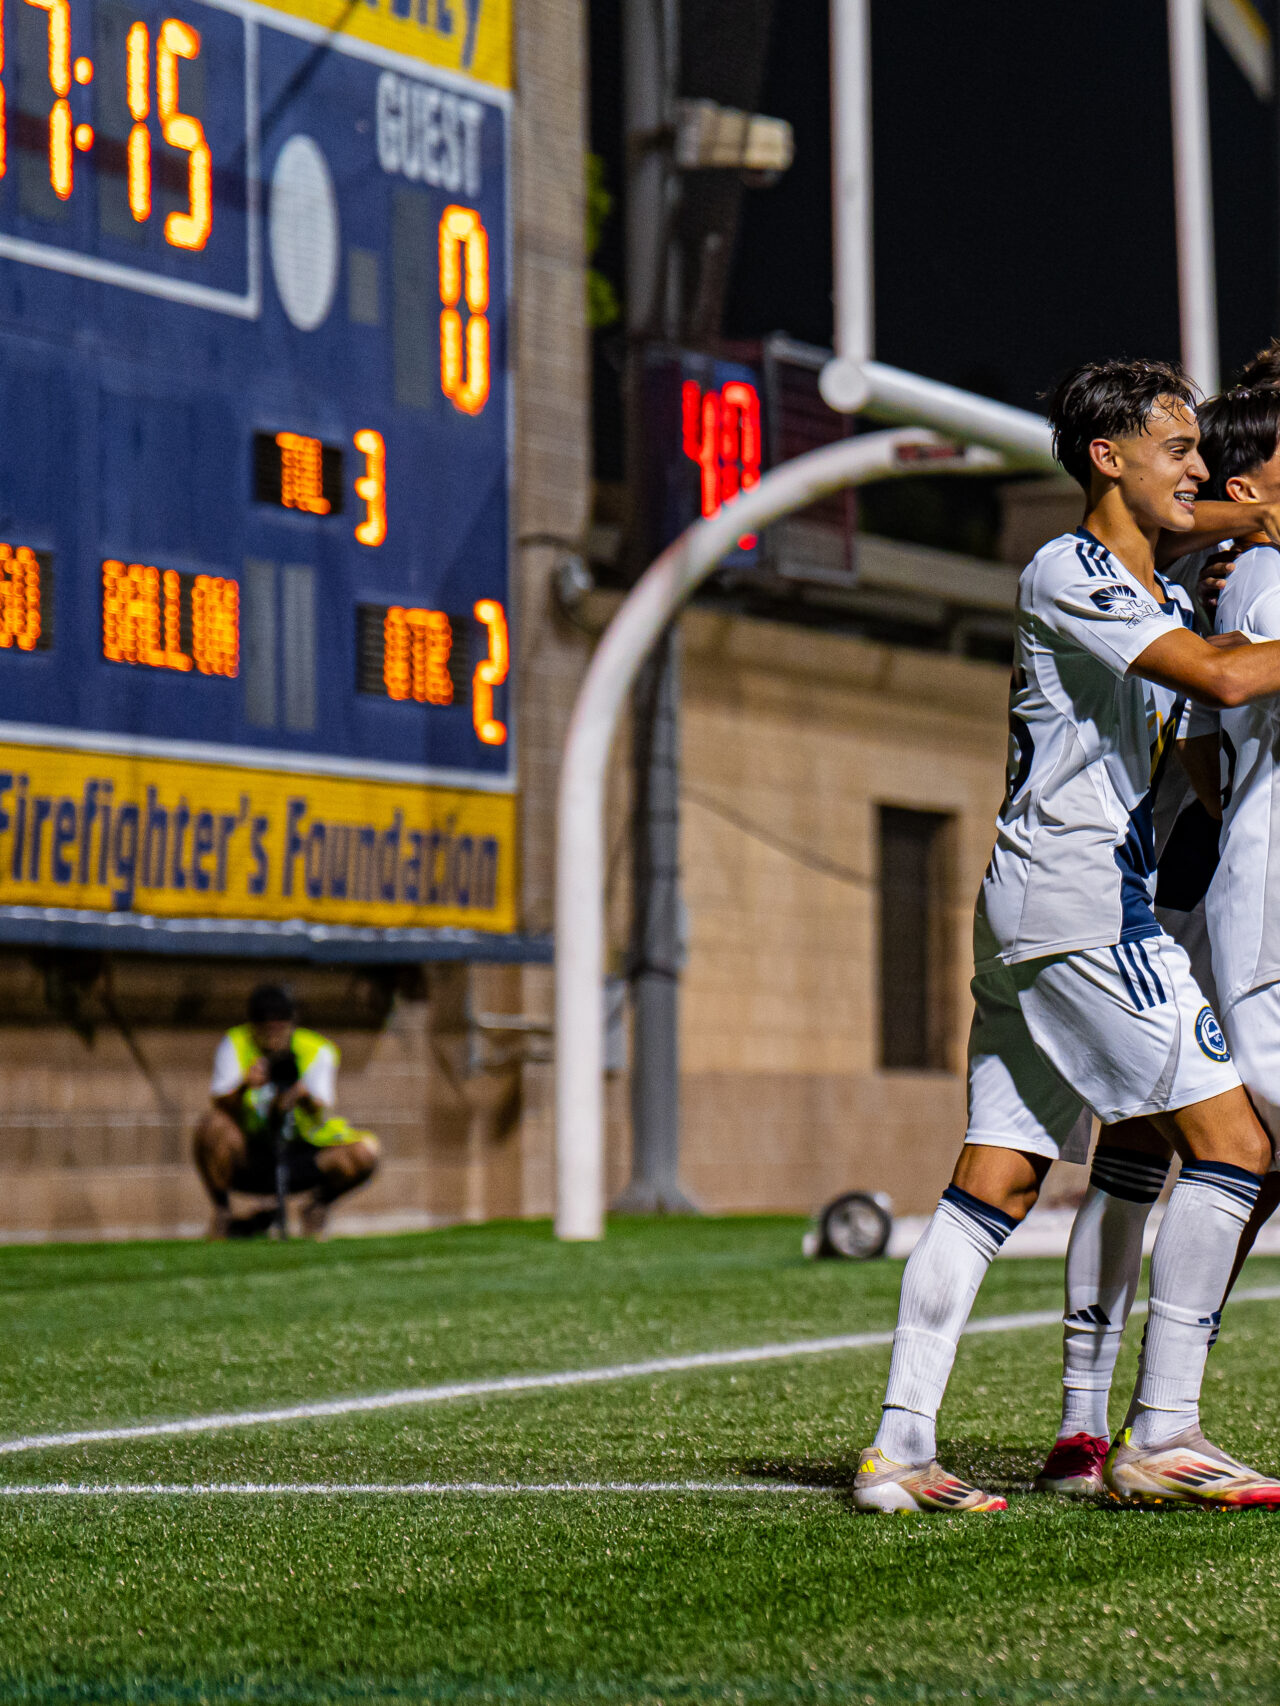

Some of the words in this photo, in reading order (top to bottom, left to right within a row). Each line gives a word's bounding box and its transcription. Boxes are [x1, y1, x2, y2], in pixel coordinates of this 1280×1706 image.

[377, 70, 484, 198] GUEST
[438, 204, 489, 416] 0
[353, 429, 388, 547] 3
[472, 599, 510, 746] 2
[283, 796, 499, 910] Foundation
